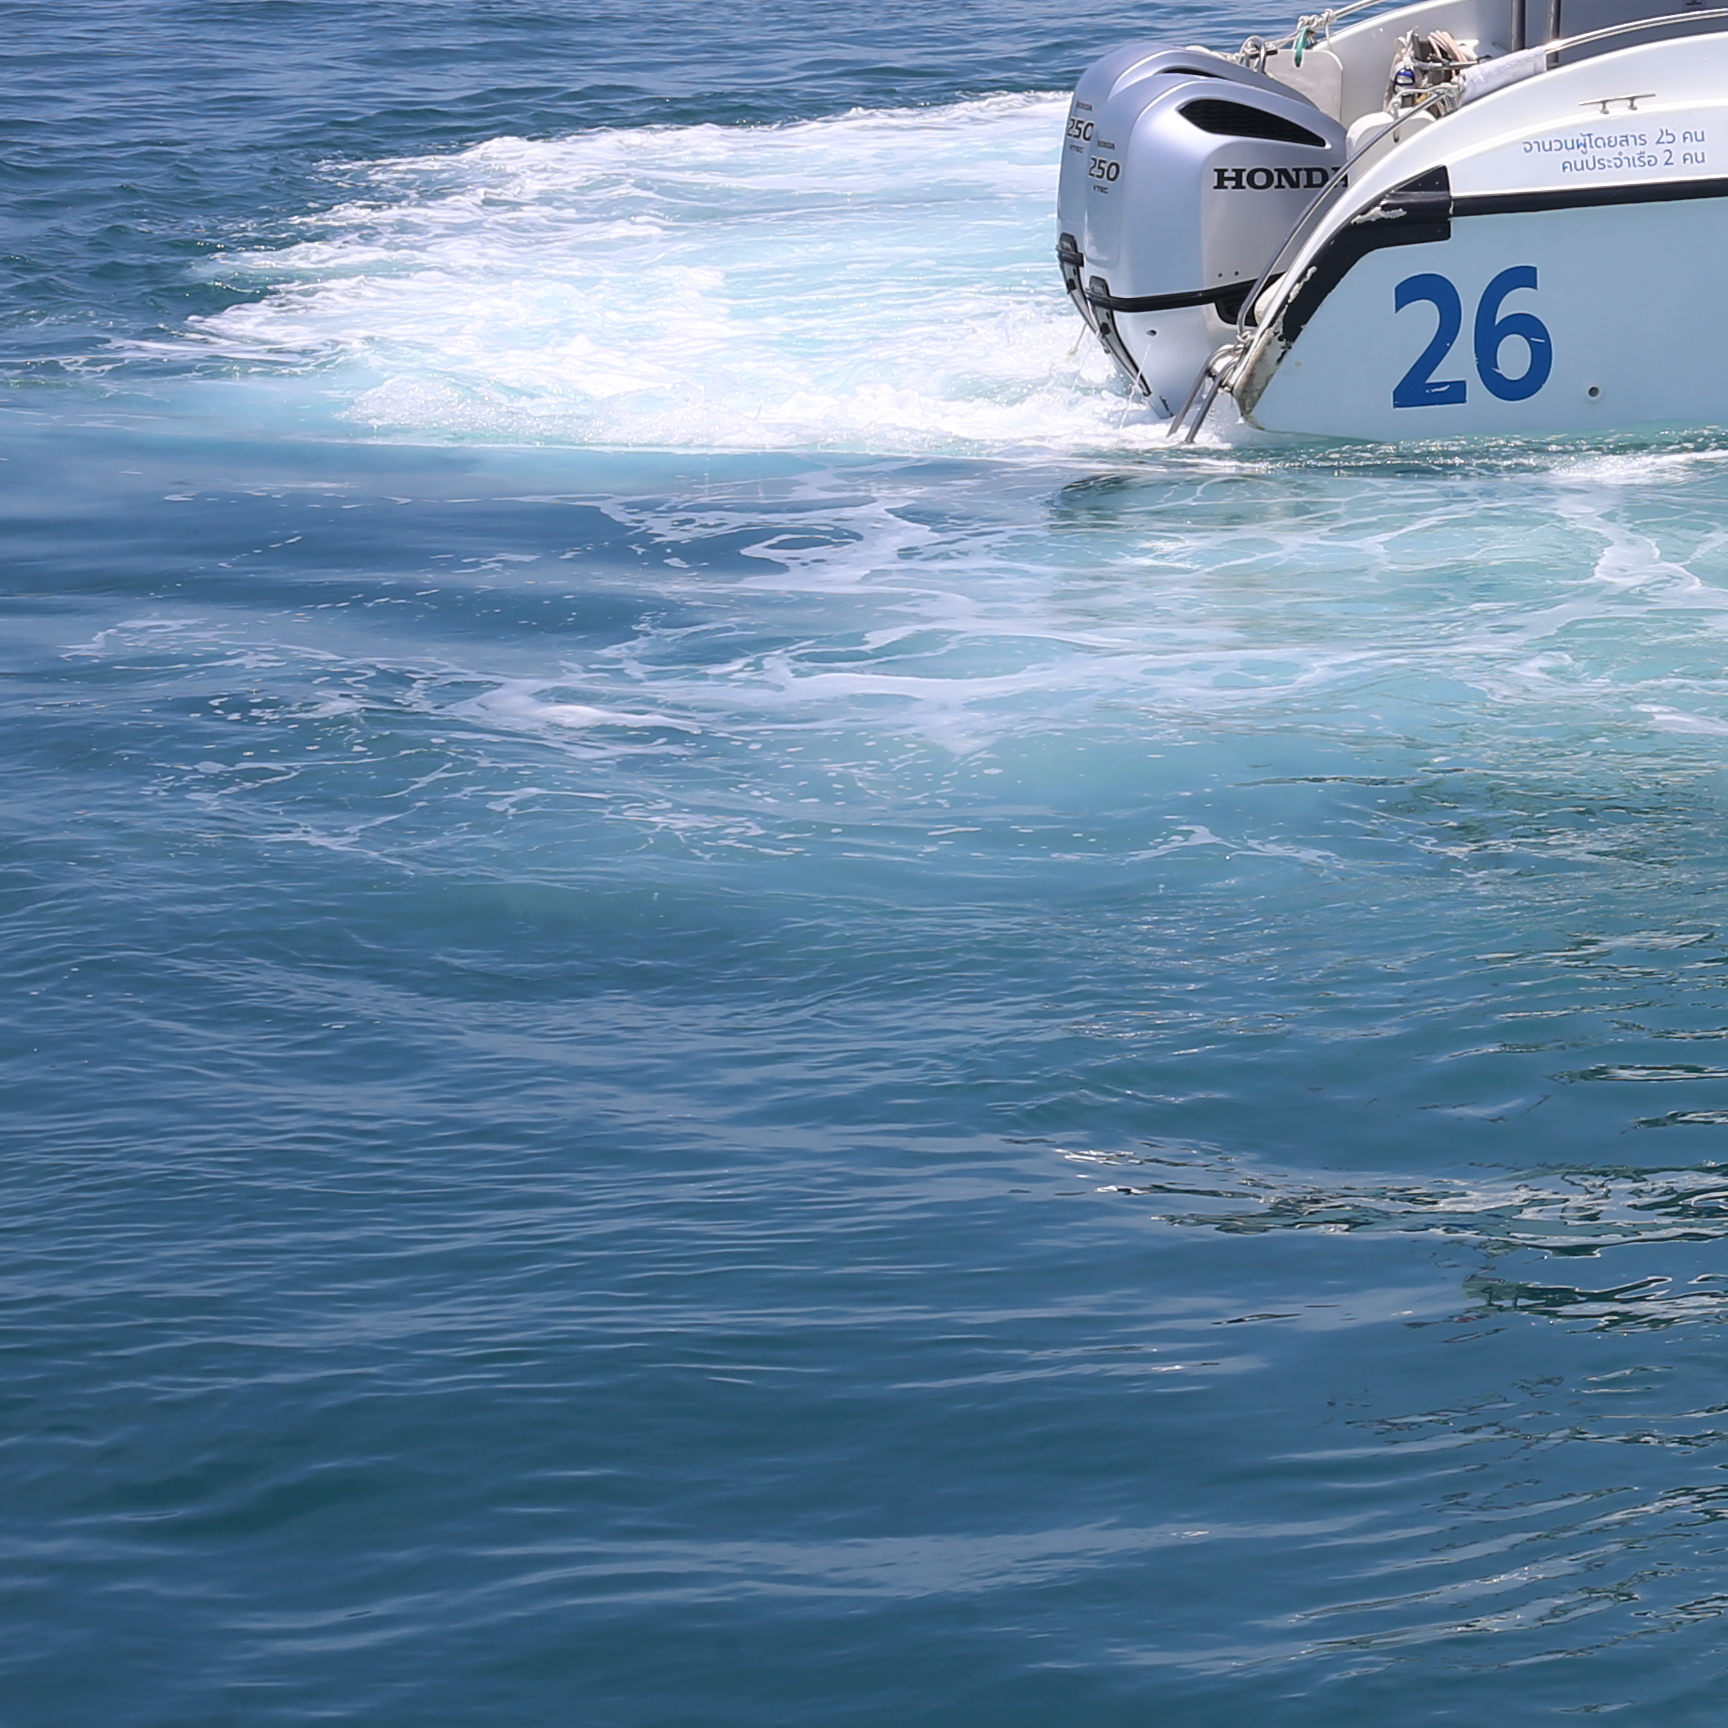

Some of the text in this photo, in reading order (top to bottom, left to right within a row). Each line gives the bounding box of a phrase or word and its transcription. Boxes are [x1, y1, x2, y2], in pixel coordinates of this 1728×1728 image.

[1682, 129, 1706, 144] คน
[1088, 156, 1121, 183] 250
[1561, 149, 1706, 172] คนประจำเรือ 2 คน
[1392, 265, 1554, 409] 26
